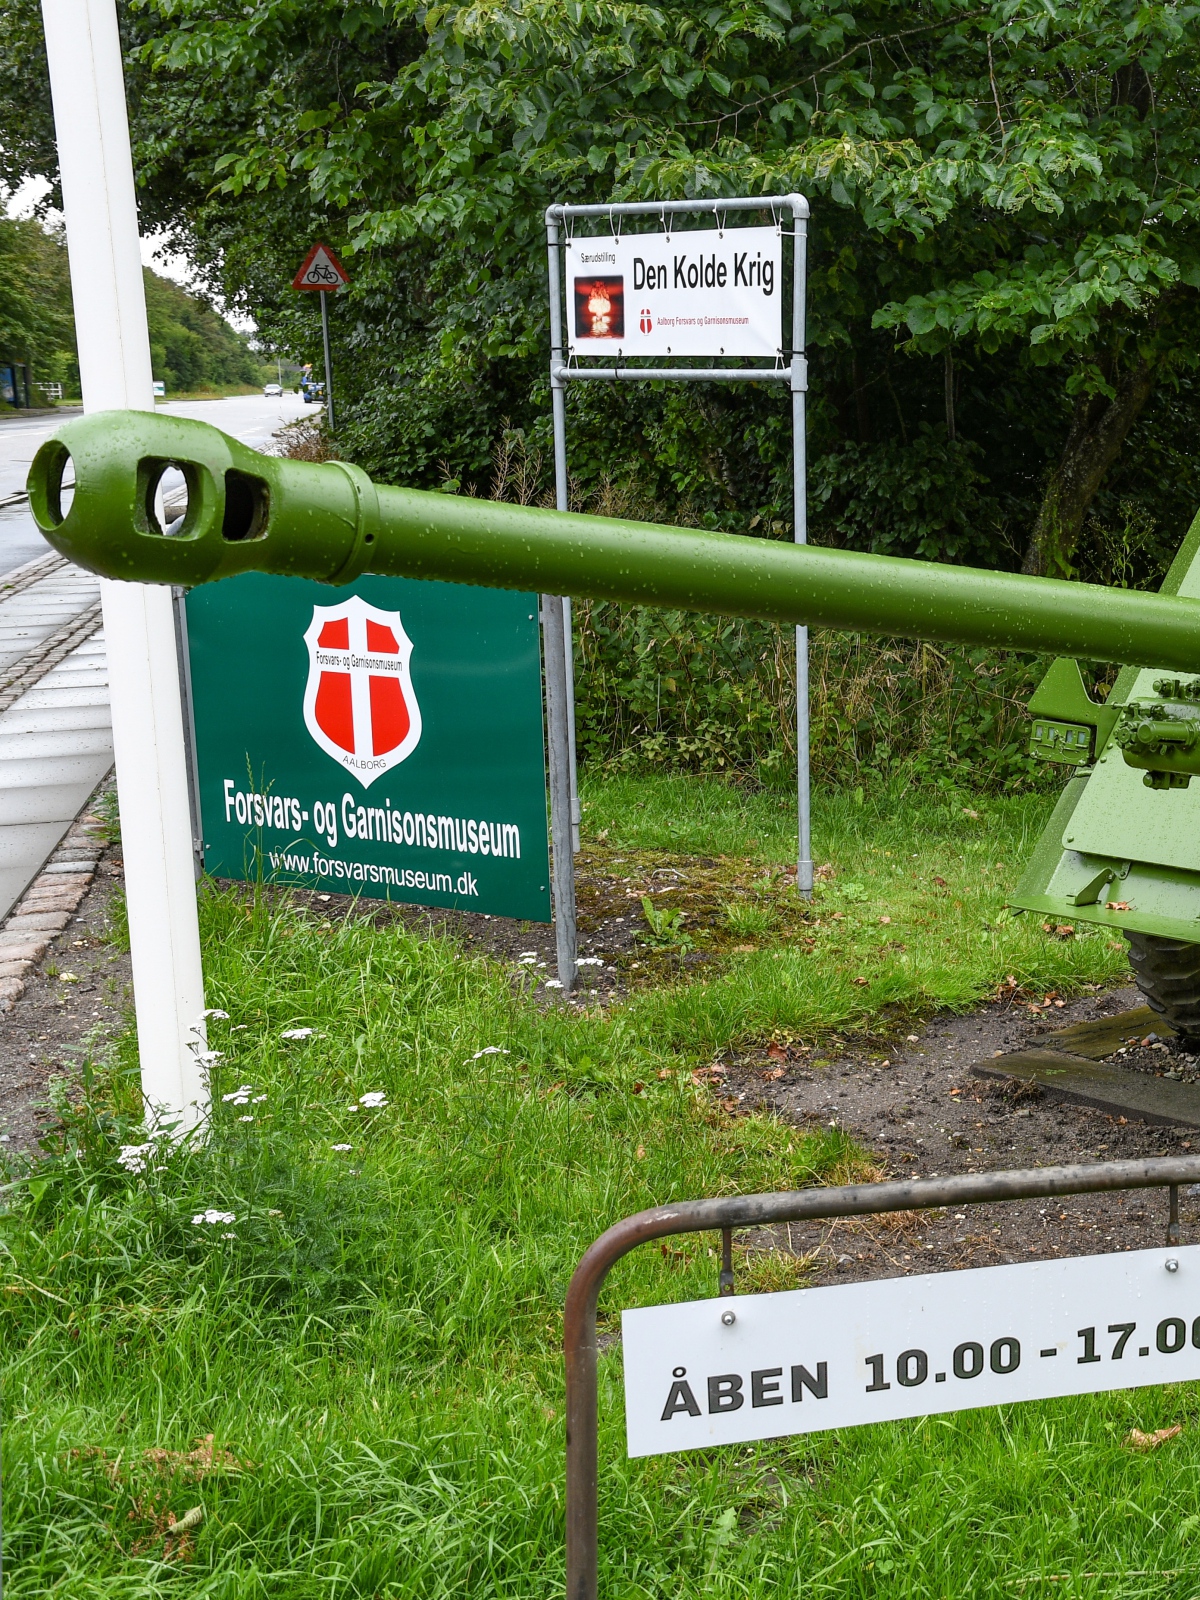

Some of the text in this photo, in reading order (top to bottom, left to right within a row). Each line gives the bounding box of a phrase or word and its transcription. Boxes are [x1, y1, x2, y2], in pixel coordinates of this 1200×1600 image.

[581, 252, 616, 264] Særudstilling
[633, 252, 774, 296] Den Kolde Krig
[657, 316, 749, 327] Aalborg Forsvars og Garnisonsmuseum
[316, 651, 403, 672] Forsvars- og Garnisonsmuseum
[343, 755, 387, 770] AALBORG
[223, 779, 521, 859] Forsvars- og Garnisonsmuseum
[269, 848, 479, 896] www.forsvarsmuseum.dk
[660, 1361, 828, 1422] ÅBEN
[864, 1336, 1020, 1392] 10.00
[1040, 1347, 1057, 1358] -
